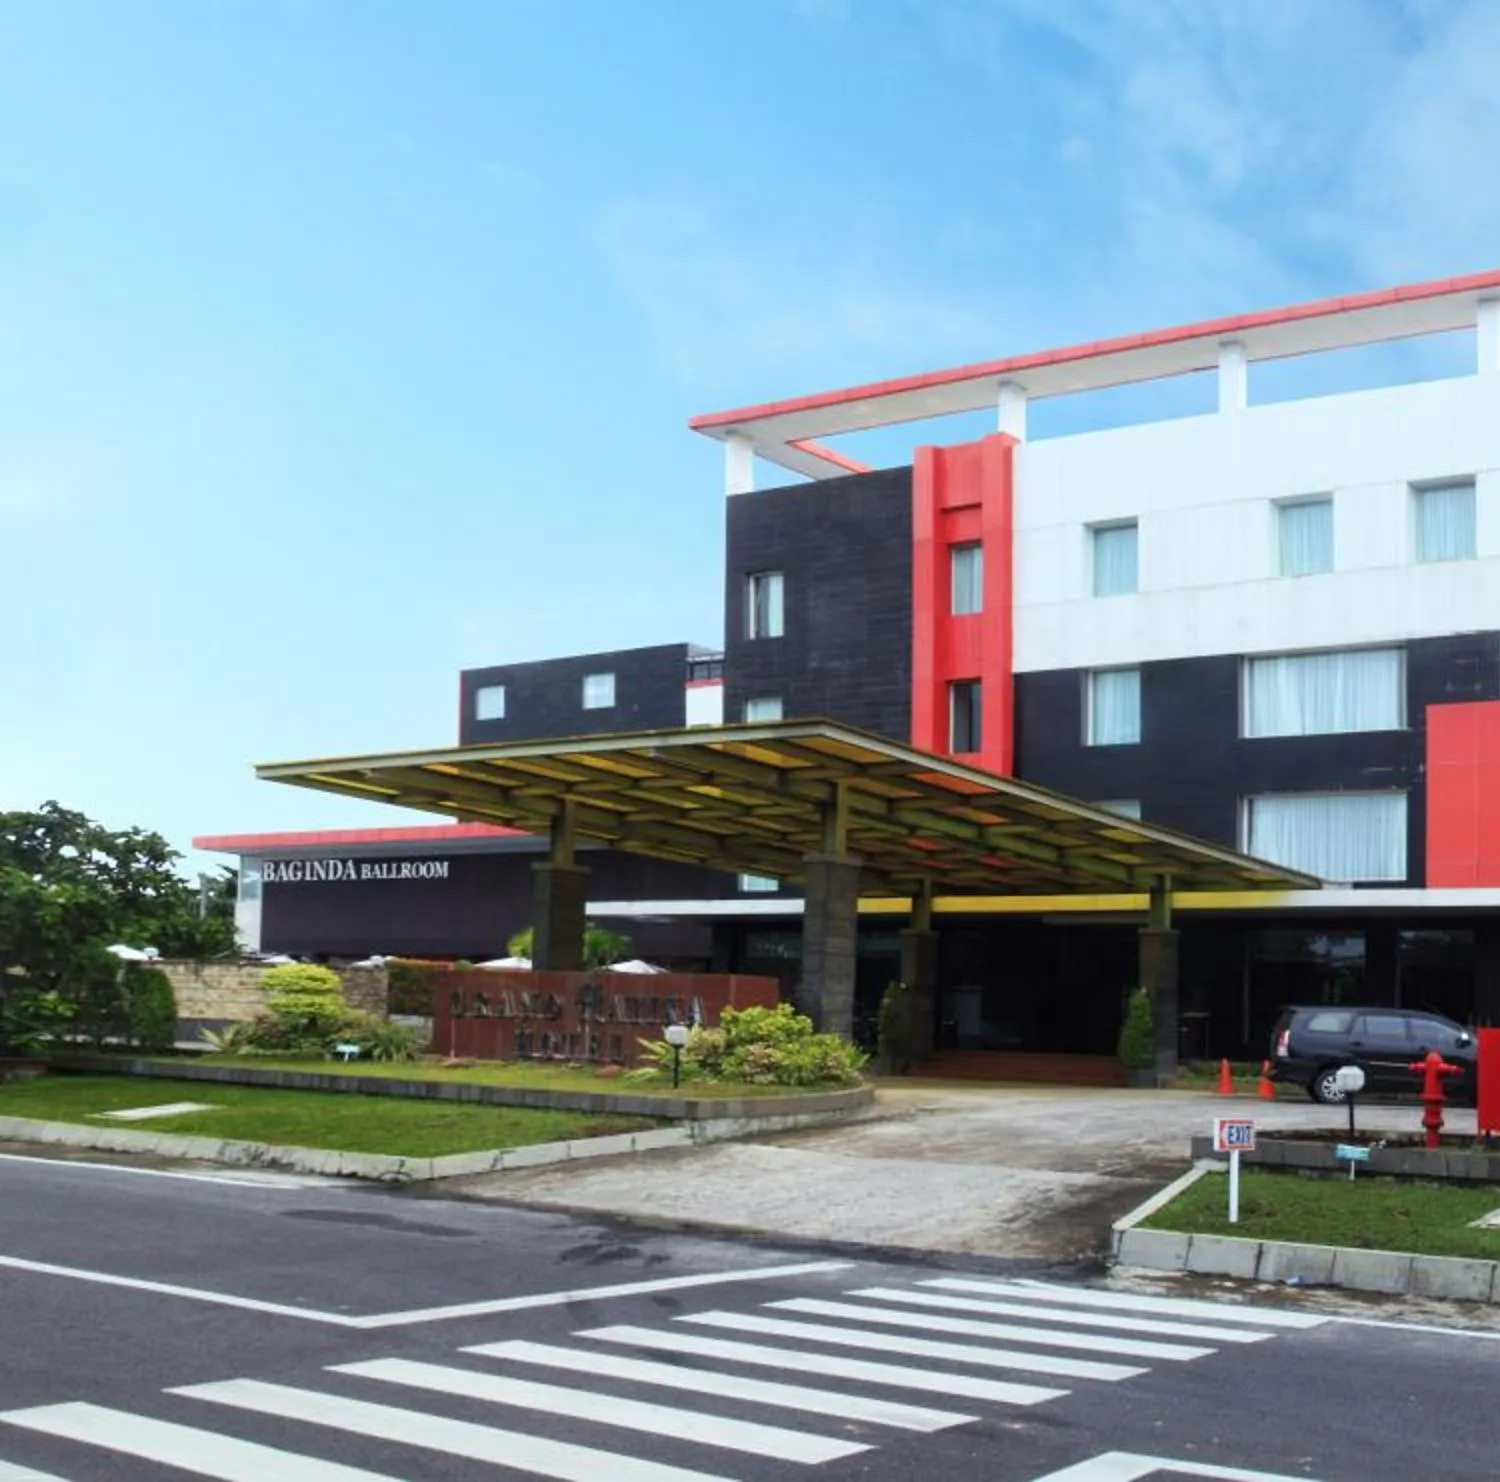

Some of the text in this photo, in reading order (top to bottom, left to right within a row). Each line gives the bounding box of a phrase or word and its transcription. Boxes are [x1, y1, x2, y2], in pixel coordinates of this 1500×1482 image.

[263, 859, 449, 882] BAGINDA BALLROOM
[1227, 1126, 1252, 1145] EXIT
